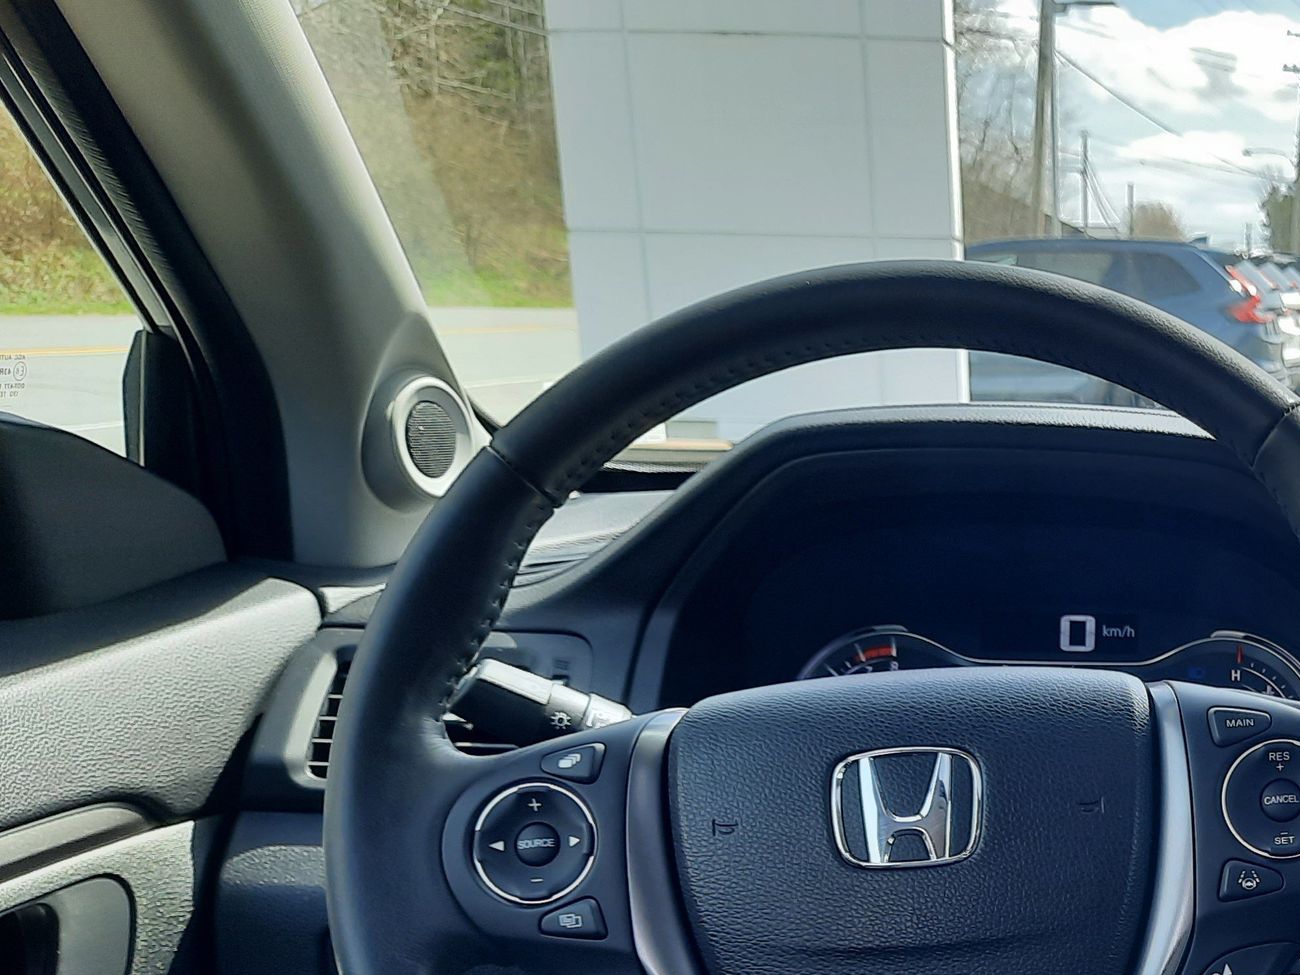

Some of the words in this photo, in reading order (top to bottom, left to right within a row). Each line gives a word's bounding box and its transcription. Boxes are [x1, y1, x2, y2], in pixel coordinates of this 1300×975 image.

[1060, 615, 1096, 652] 0
[1102, 624, 1135, 640] km/h
[1231, 669, 1241, 682] H
[1226, 718, 1254, 728] MAIN
[1268, 751, 1290, 761] RES
[1263, 794, 1300, 805] CANCEL
[517, 839, 555, 850] SOURCE
[1274, 836, 1295, 845] SET
